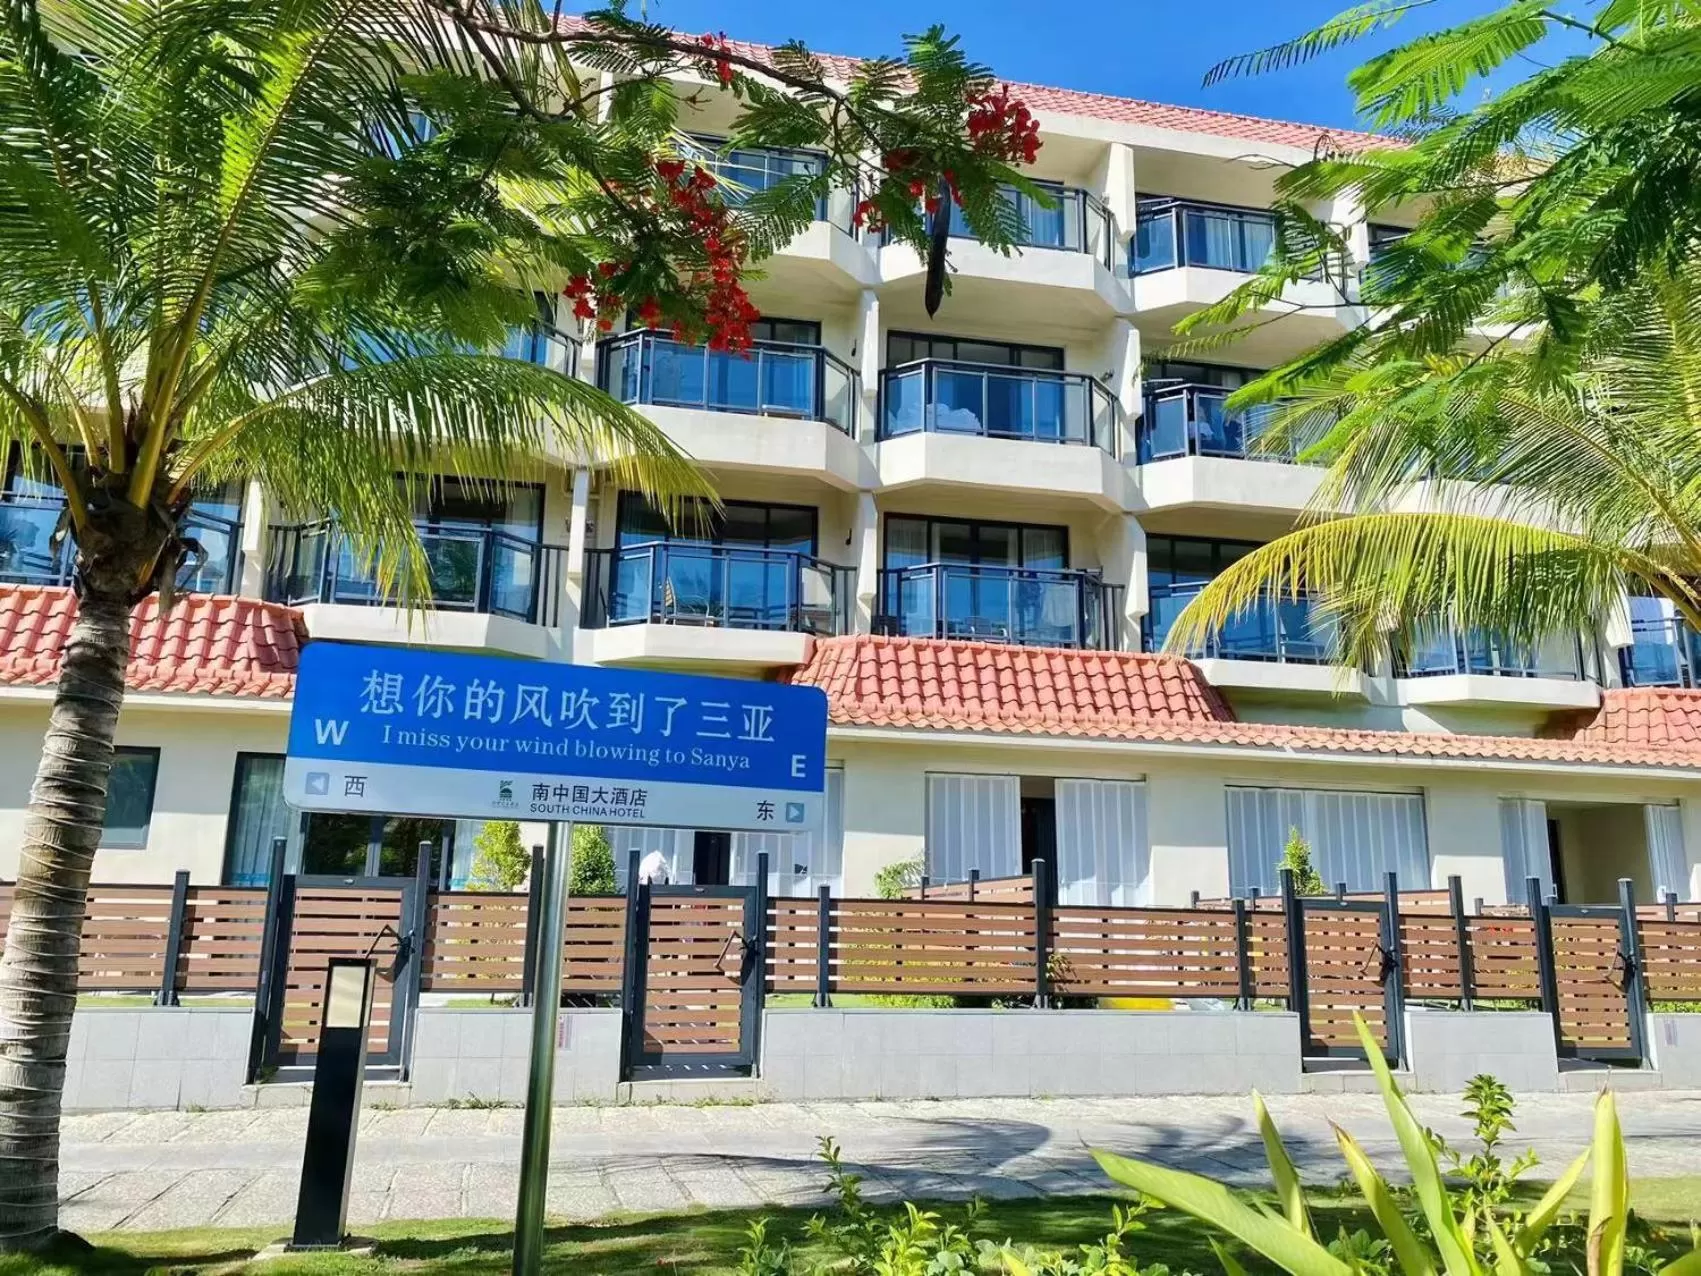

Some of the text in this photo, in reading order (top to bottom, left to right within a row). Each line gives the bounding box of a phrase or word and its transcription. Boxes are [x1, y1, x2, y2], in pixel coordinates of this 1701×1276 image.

[360, 668, 775, 742] 想你的风吹到了三亚
[315, 718, 350, 746] W
[382, 725, 751, 772] I miss your wind blowing to Sanya
[790, 754, 807, 778] E
[344, 775, 368, 798] 西
[531, 782, 648, 807] 南中国大酒店
[530, 803, 570, 815] SOUTH
[572, 805, 610, 817] CHINA
[609, 808, 646, 819] HOTEL
[756, 800, 775, 822] 东
